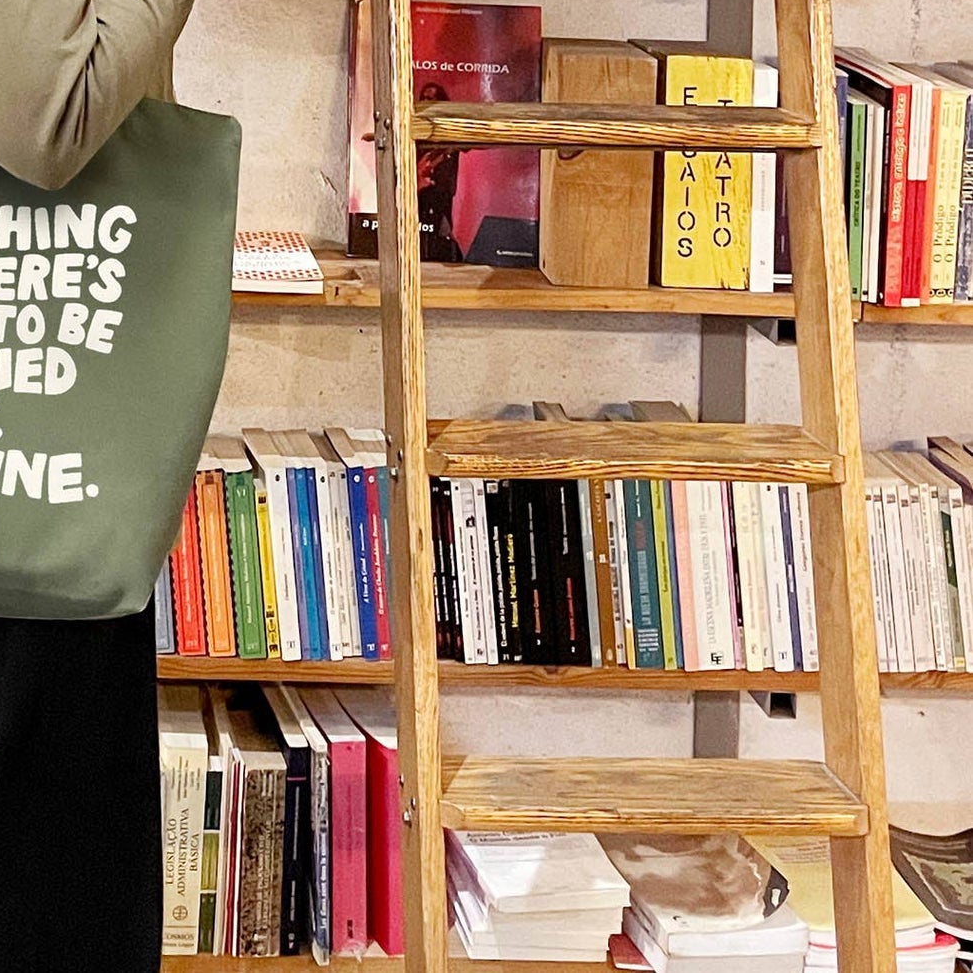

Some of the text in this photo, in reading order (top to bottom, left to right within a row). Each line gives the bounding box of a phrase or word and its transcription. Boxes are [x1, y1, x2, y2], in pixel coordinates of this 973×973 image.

[439, 61, 455, 71] de
[456, 61, 510, 75] CORRIDA
[853, 161, 862, 227] CRÍTICA DO TEATRO
[932, 204, 945, 263] O Pródigo
[943, 204, 957, 263] O Pródigo
[57, 302, 124, 354] BE
[506, 533, 519, 628] Manuel Martínez Mediero
[165, 818, 178, 885] LEGISLAÇÃO
[177, 807, 190, 897] ADMINISTRATIVA
[189, 833, 200, 872] BÁSICA
